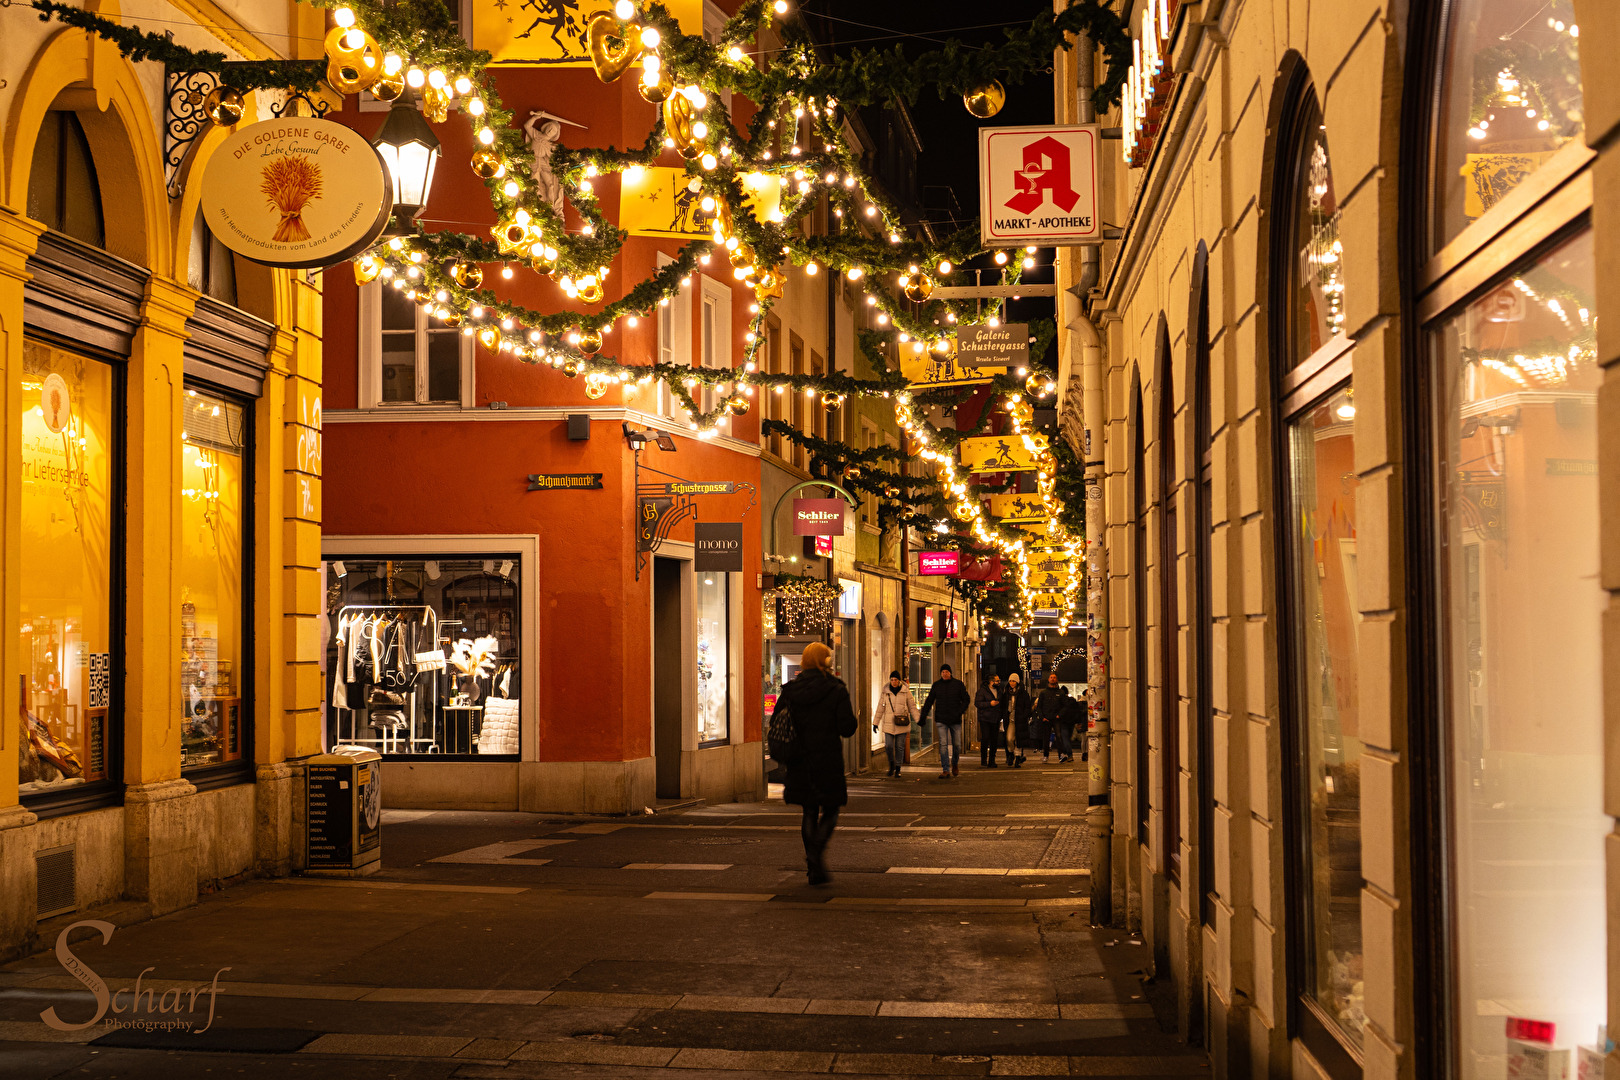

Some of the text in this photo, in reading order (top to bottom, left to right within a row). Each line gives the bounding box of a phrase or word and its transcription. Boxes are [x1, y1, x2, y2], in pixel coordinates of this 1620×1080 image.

[233, 128, 350, 160] DIE GOLDENE GARBE
[260, 140, 326, 157] Lebe Gesund
[220, 207, 230, 221] mit
[227, 220, 287, 251] Heimatprodukten
[308, 237, 327, 248] Land
[329, 229, 342, 240] des
[341, 201, 364, 230] Friedens
[976, 330, 1010, 342] Galerie
[961, 341, 1026, 353] Schustergasse
[538, 475, 595, 488] Schmalzmarkt
[671, 483, 728, 494] Schustergasse
[798, 511, 839, 520] Schlier
[699, 540, 738, 549] momo
[923, 558, 957, 566] Schlier
